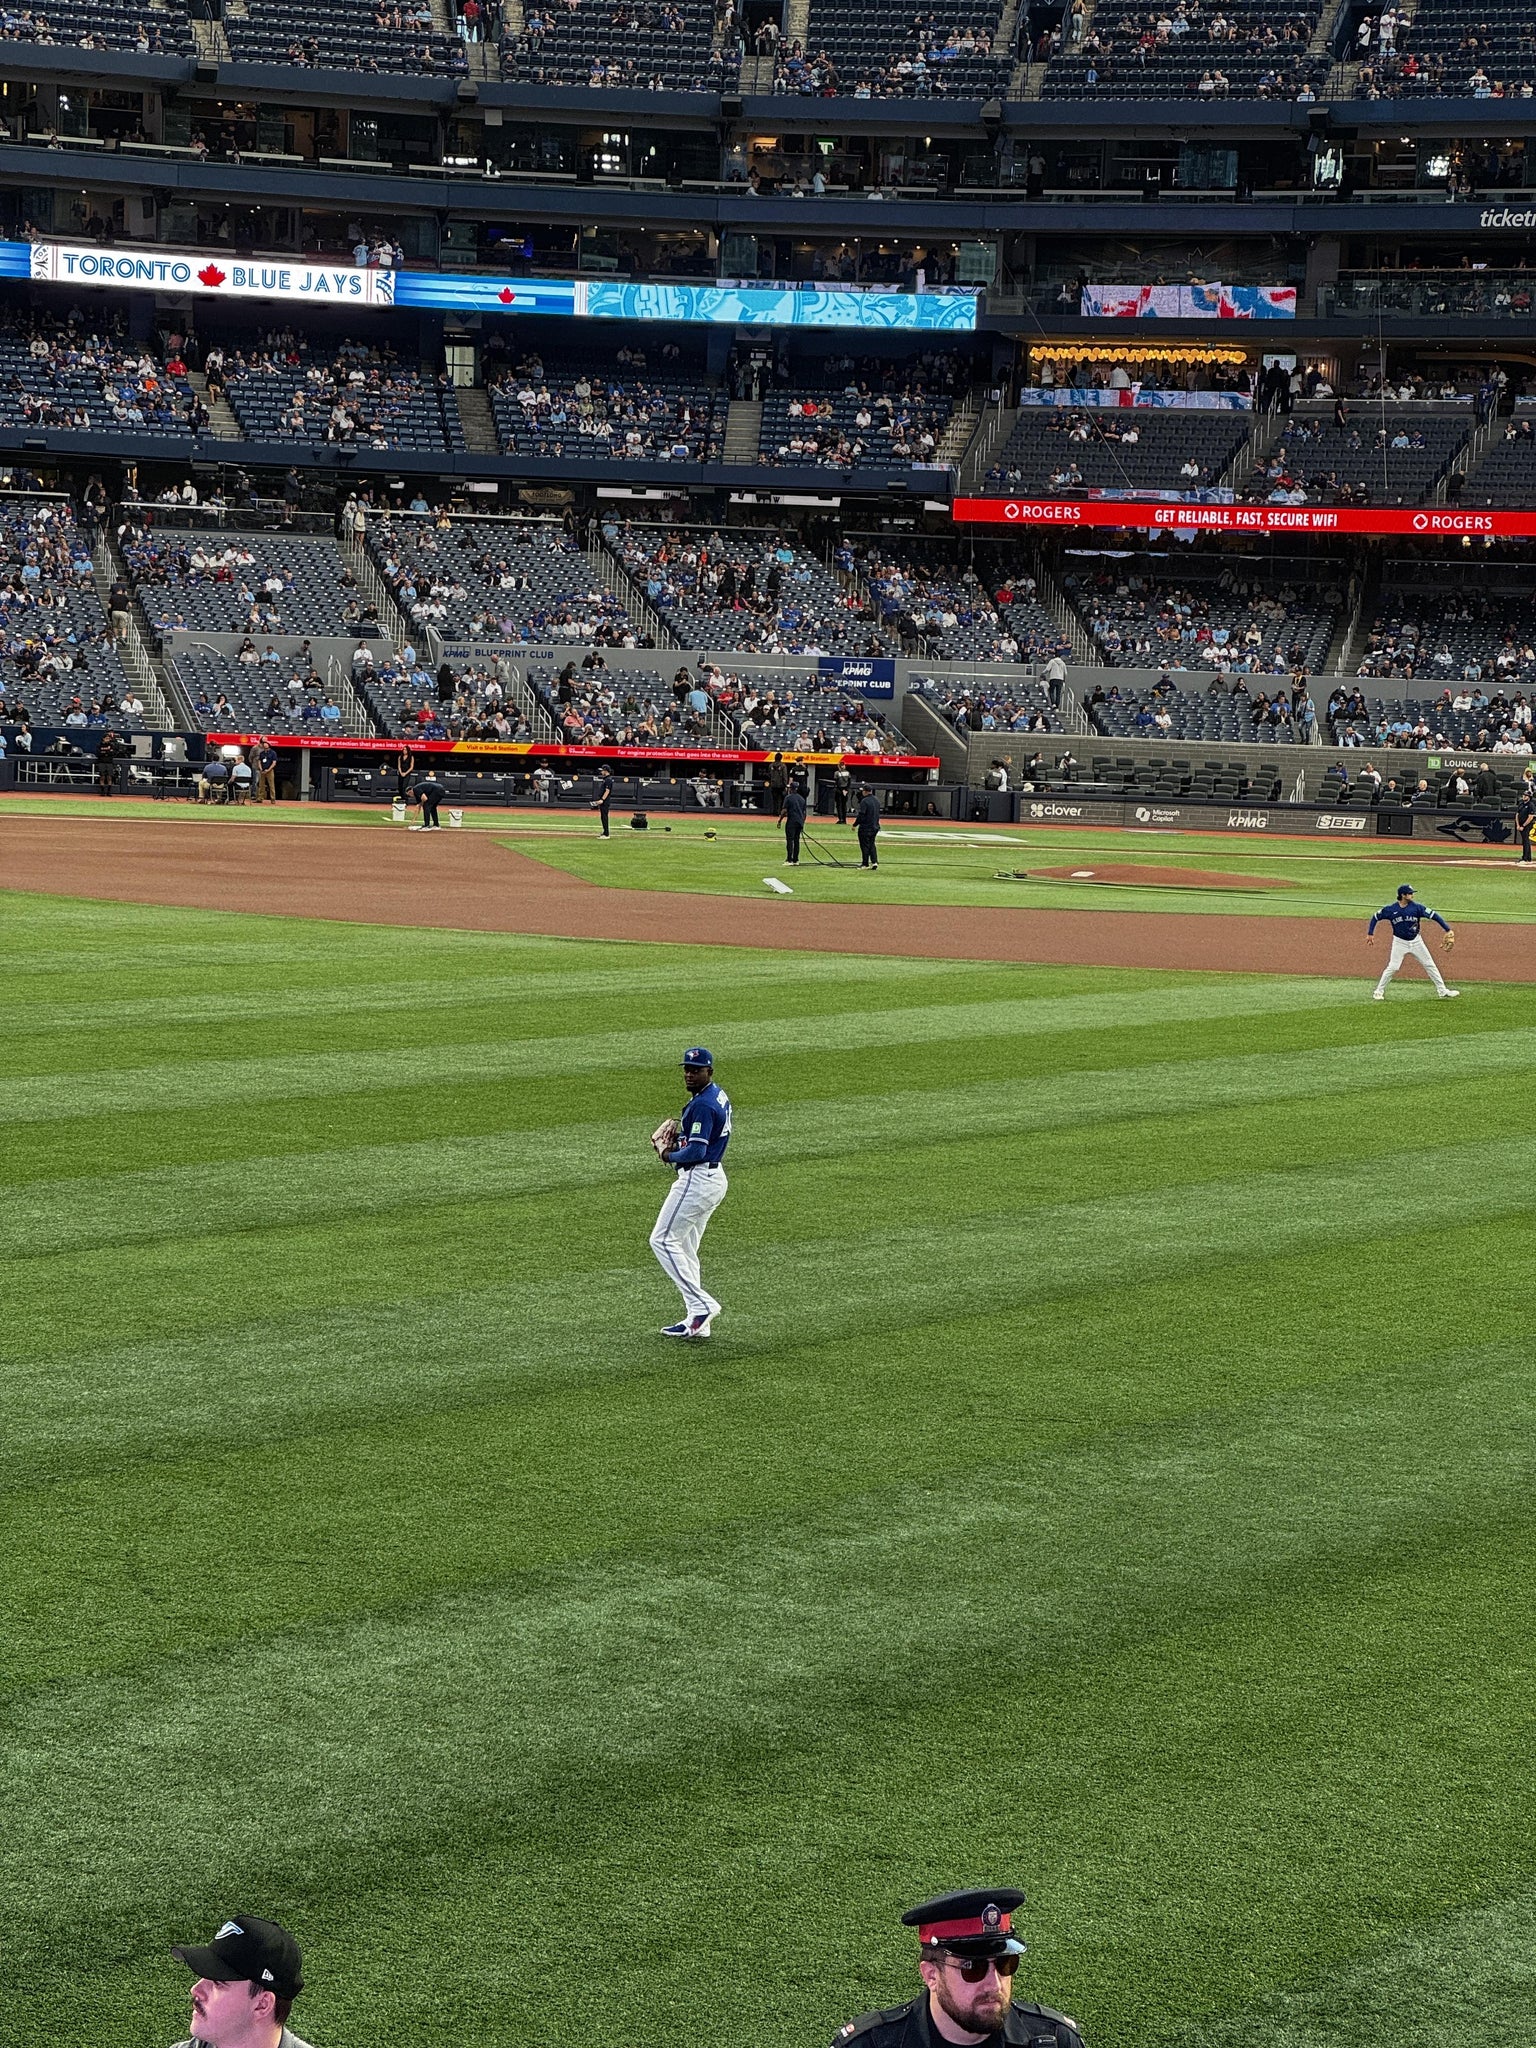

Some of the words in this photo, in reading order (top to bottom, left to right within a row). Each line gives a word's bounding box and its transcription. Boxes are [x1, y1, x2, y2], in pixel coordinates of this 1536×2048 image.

[1480, 208, 1536, 227] ticket
[63, 253, 191, 282] TORONTO
[233, 267, 291, 290] BLUE
[299, 272, 362, 295] JAYS
[1023, 505, 1081, 519] ROGERS
[1154, 509, 1175, 523] GET
[1178, 510, 1233, 526] RELIABLE,
[1236, 511, 1264, 527] FAST,
[1267, 512, 1309, 527] SECURE
[1312, 513, 1338, 527] WIFI
[1431, 516, 1493, 530] ROGERS
[442, 649, 471, 659] KPMG
[475, 648, 527, 659] BLUEPRINT
[529, 650, 554, 660] CLUB
[842, 666, 873, 676] KPMG
[869, 680, 891, 689] CLUB
[1444, 759, 1479, 768] LOUNGE
[1044, 803, 1083, 817] clover
[1152, 808, 1180, 817] Microsoft
[1151, 815, 1174, 823] Copilot
[1227, 816, 1267, 828] KPMG
